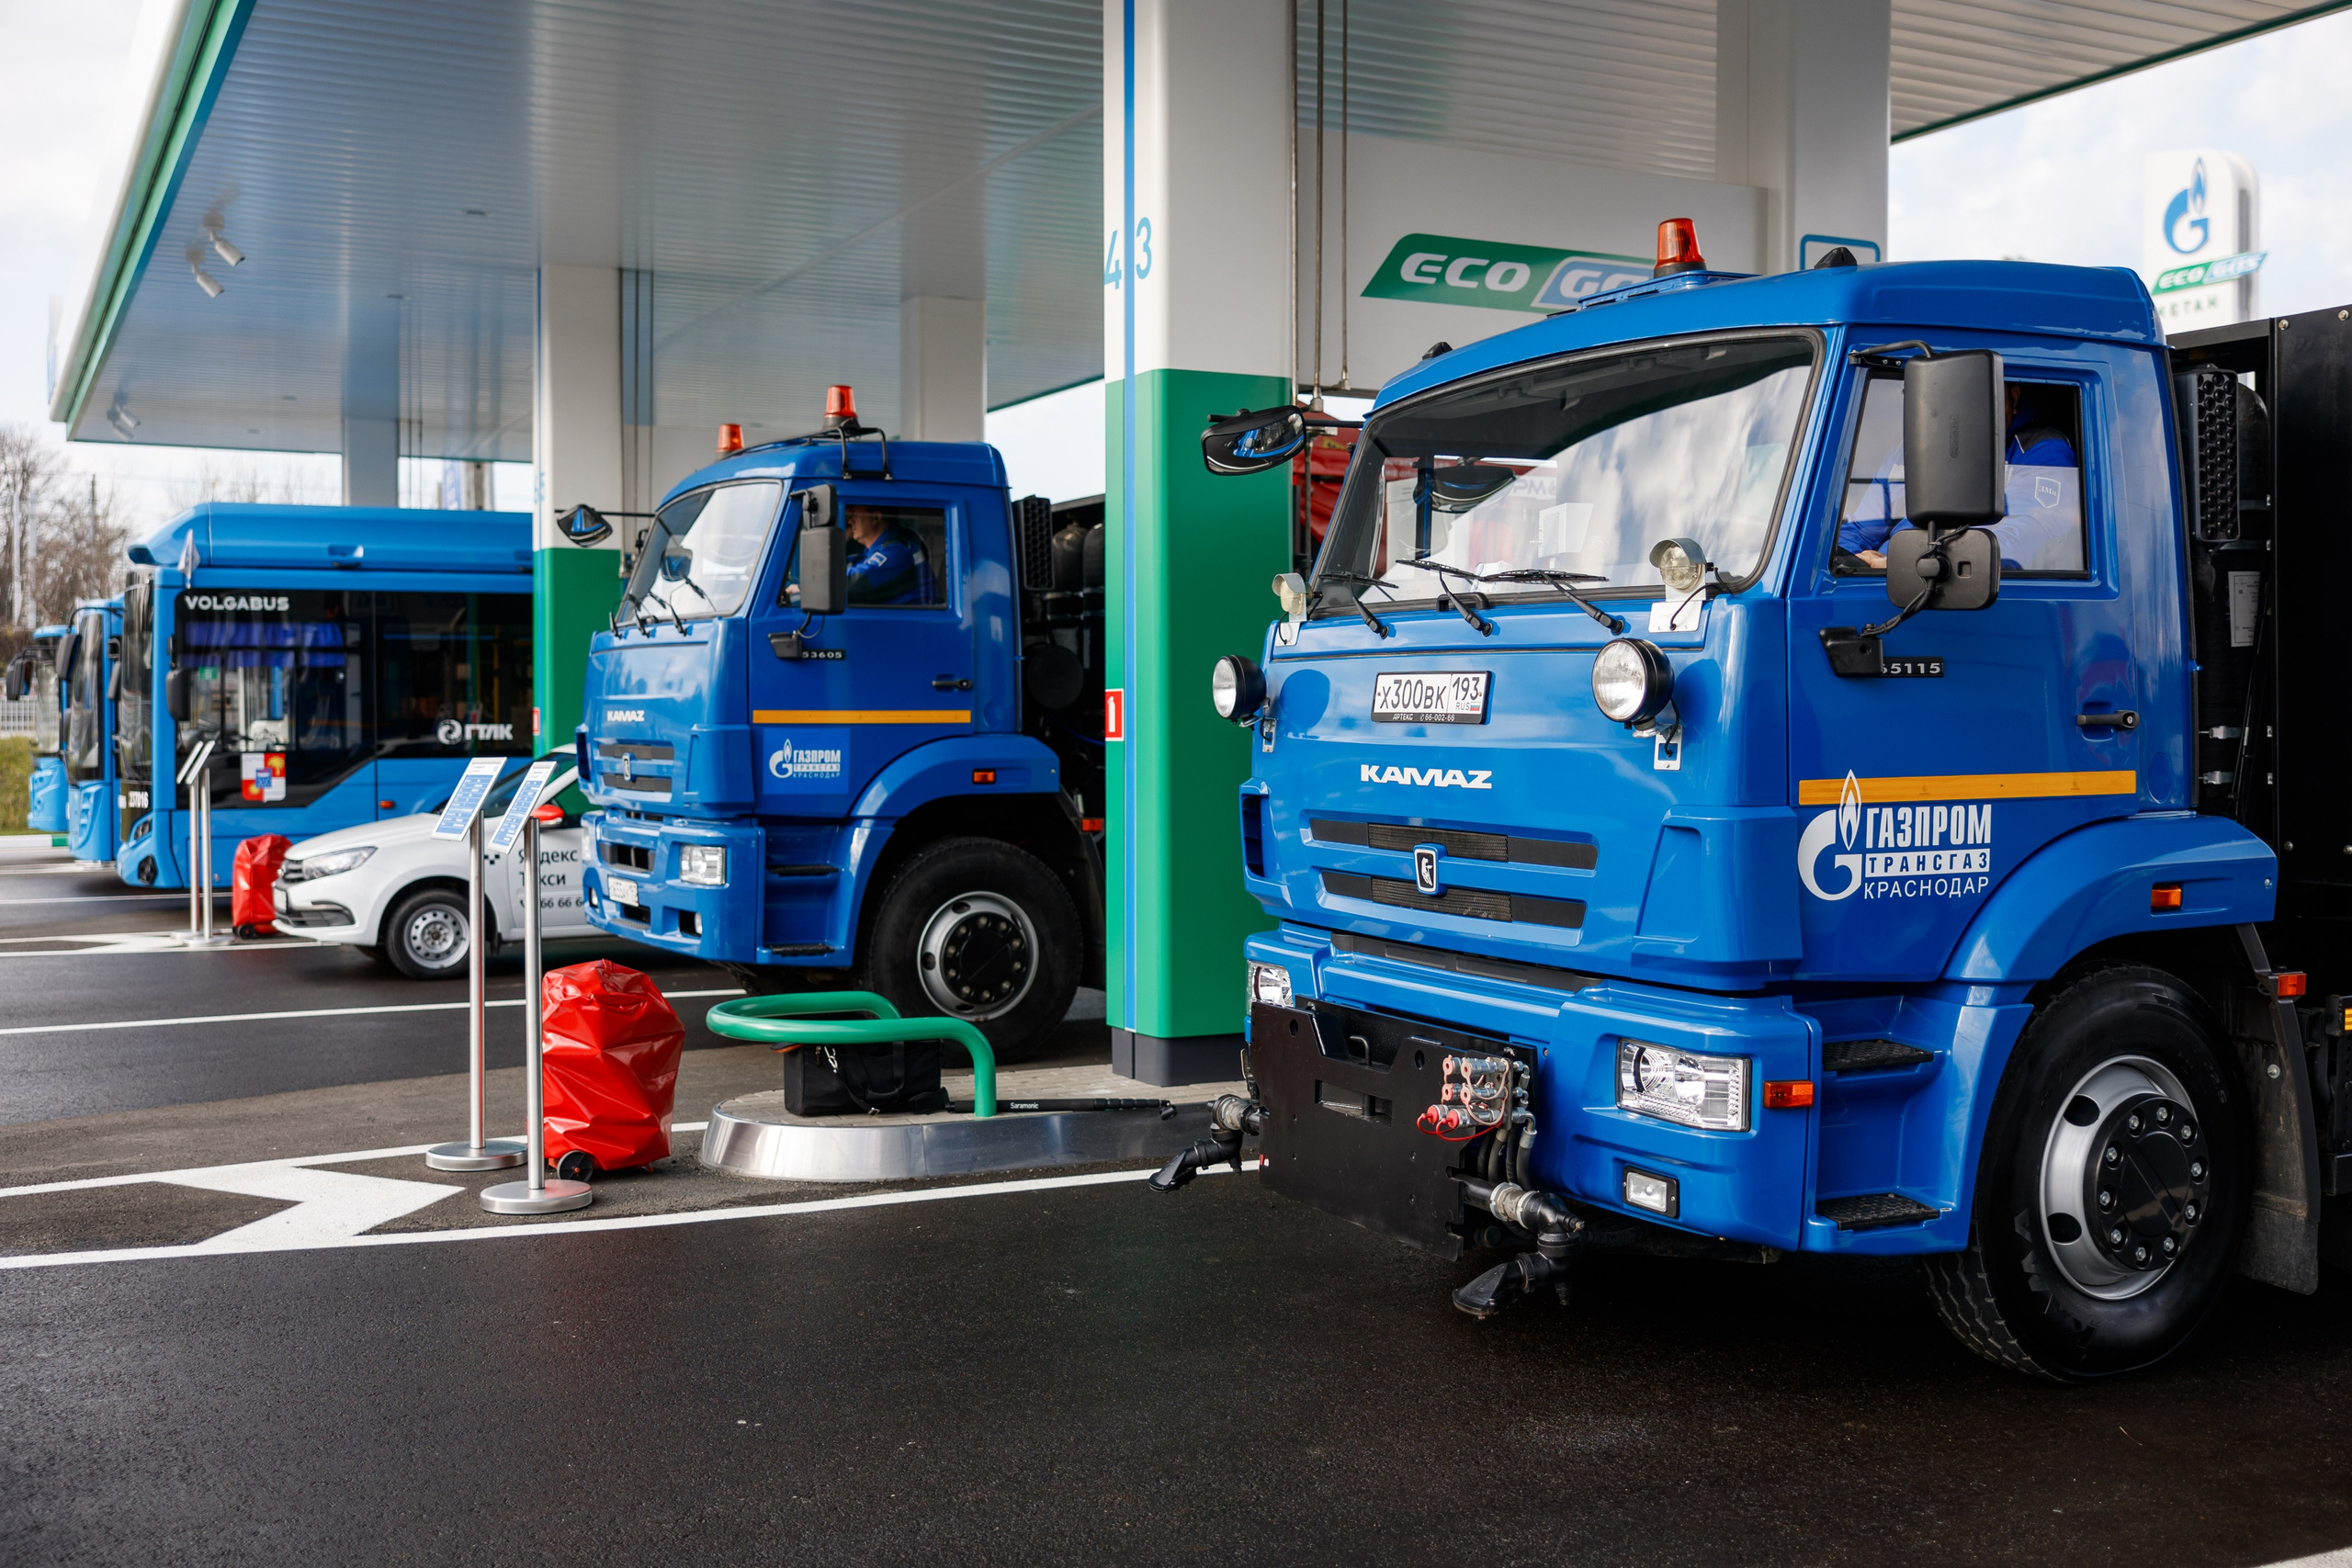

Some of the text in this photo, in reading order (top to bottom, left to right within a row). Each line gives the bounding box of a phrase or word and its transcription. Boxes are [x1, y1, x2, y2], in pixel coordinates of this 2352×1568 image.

[1136, 216, 1152, 280] 3
[1103, 230, 1122, 290] 4
[1400, 252, 1532, 293] ECO
[2158, 267, 2205, 289] ECO
[185, 595, 289, 612] VOLGABUS
[802, 650, 842, 660] 53605
[1453, 676, 1480, 701] 193
[1455, 702, 1470, 711] RUS
[607, 709, 645, 722] KAMAZ
[464, 724, 514, 740] ГТЛК
[793, 750, 841, 763] ГАЗПРОМ
[795, 763, 840, 772] ТРАНСГАЗ
[1361, 764, 1493, 790] KAMAZ
[1865, 804, 1992, 849] ГАЗПРОМ
[518, 849, 579, 864] Ядекс
[1868, 852, 1987, 874] ТРАНСГАЗ
[519, 872, 566, 886] Ткси
[1864, 876, 1989, 899] КРАСНОДАР
[558, 897, 572, 908] 66
